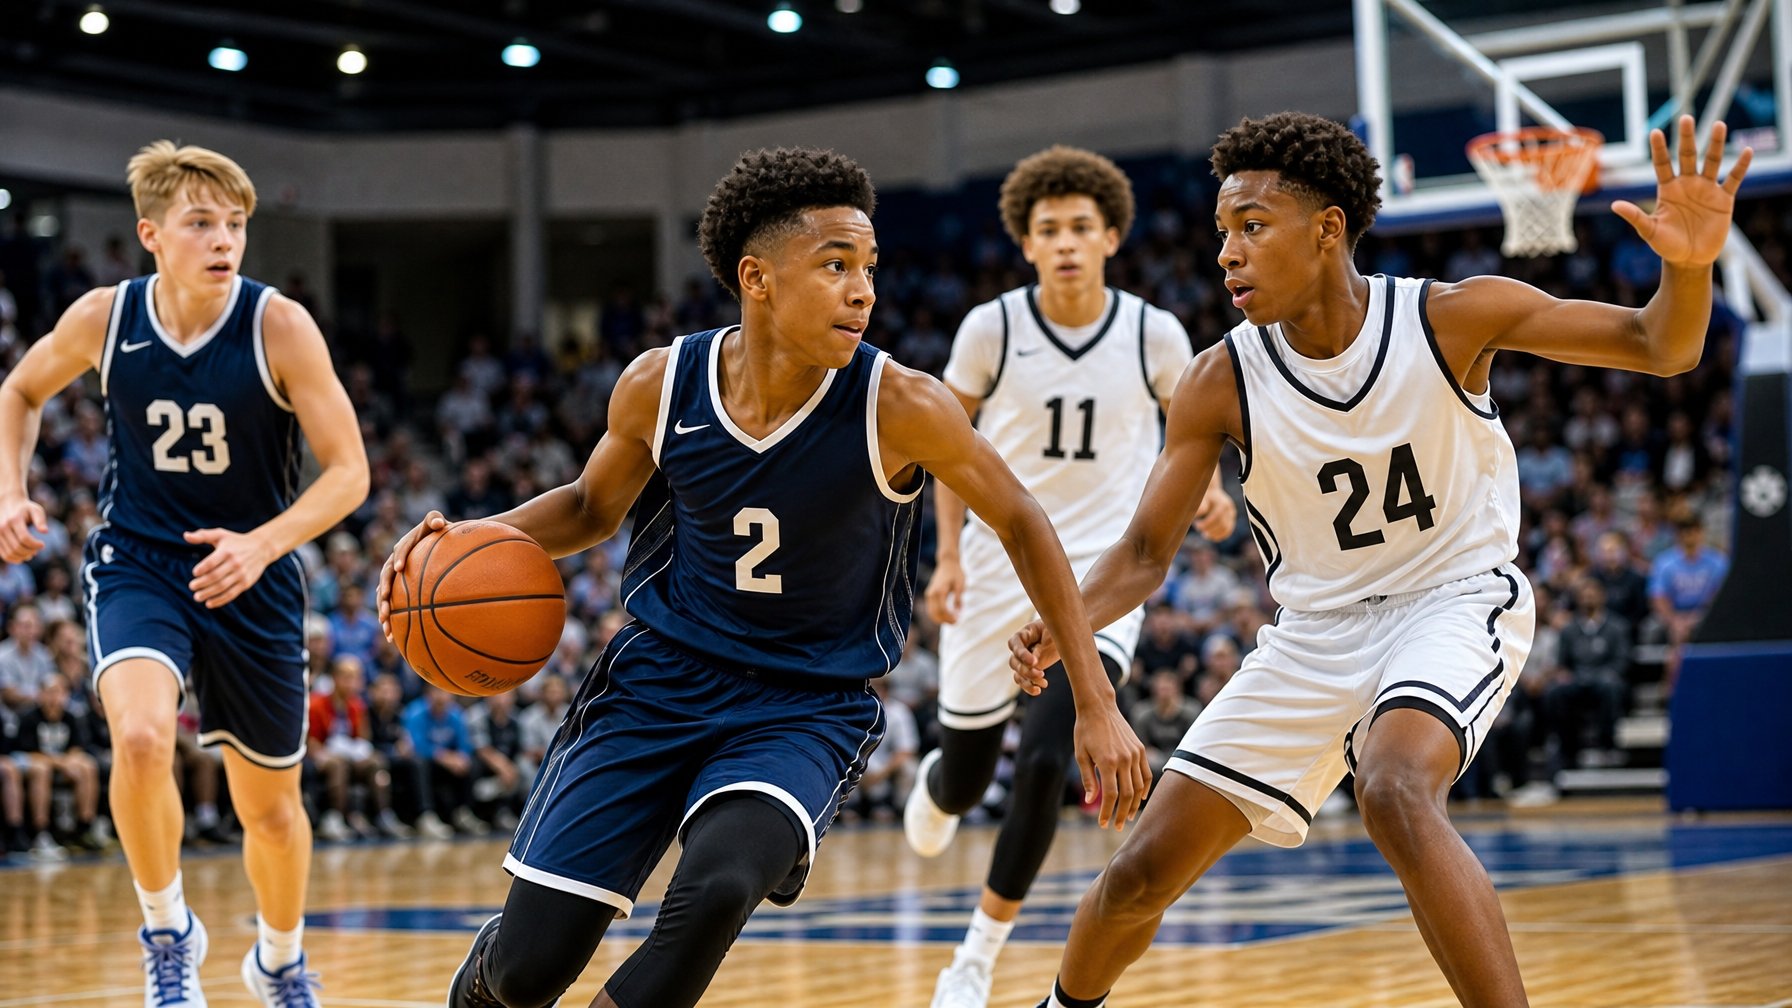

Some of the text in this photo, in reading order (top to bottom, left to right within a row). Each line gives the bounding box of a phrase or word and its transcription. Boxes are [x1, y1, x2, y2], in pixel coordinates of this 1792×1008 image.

[147, 400, 230, 474] 23
[1043, 397, 1096, 460] 11
[1317, 443, 1436, 550] 24
[734, 508, 782, 594] 2
